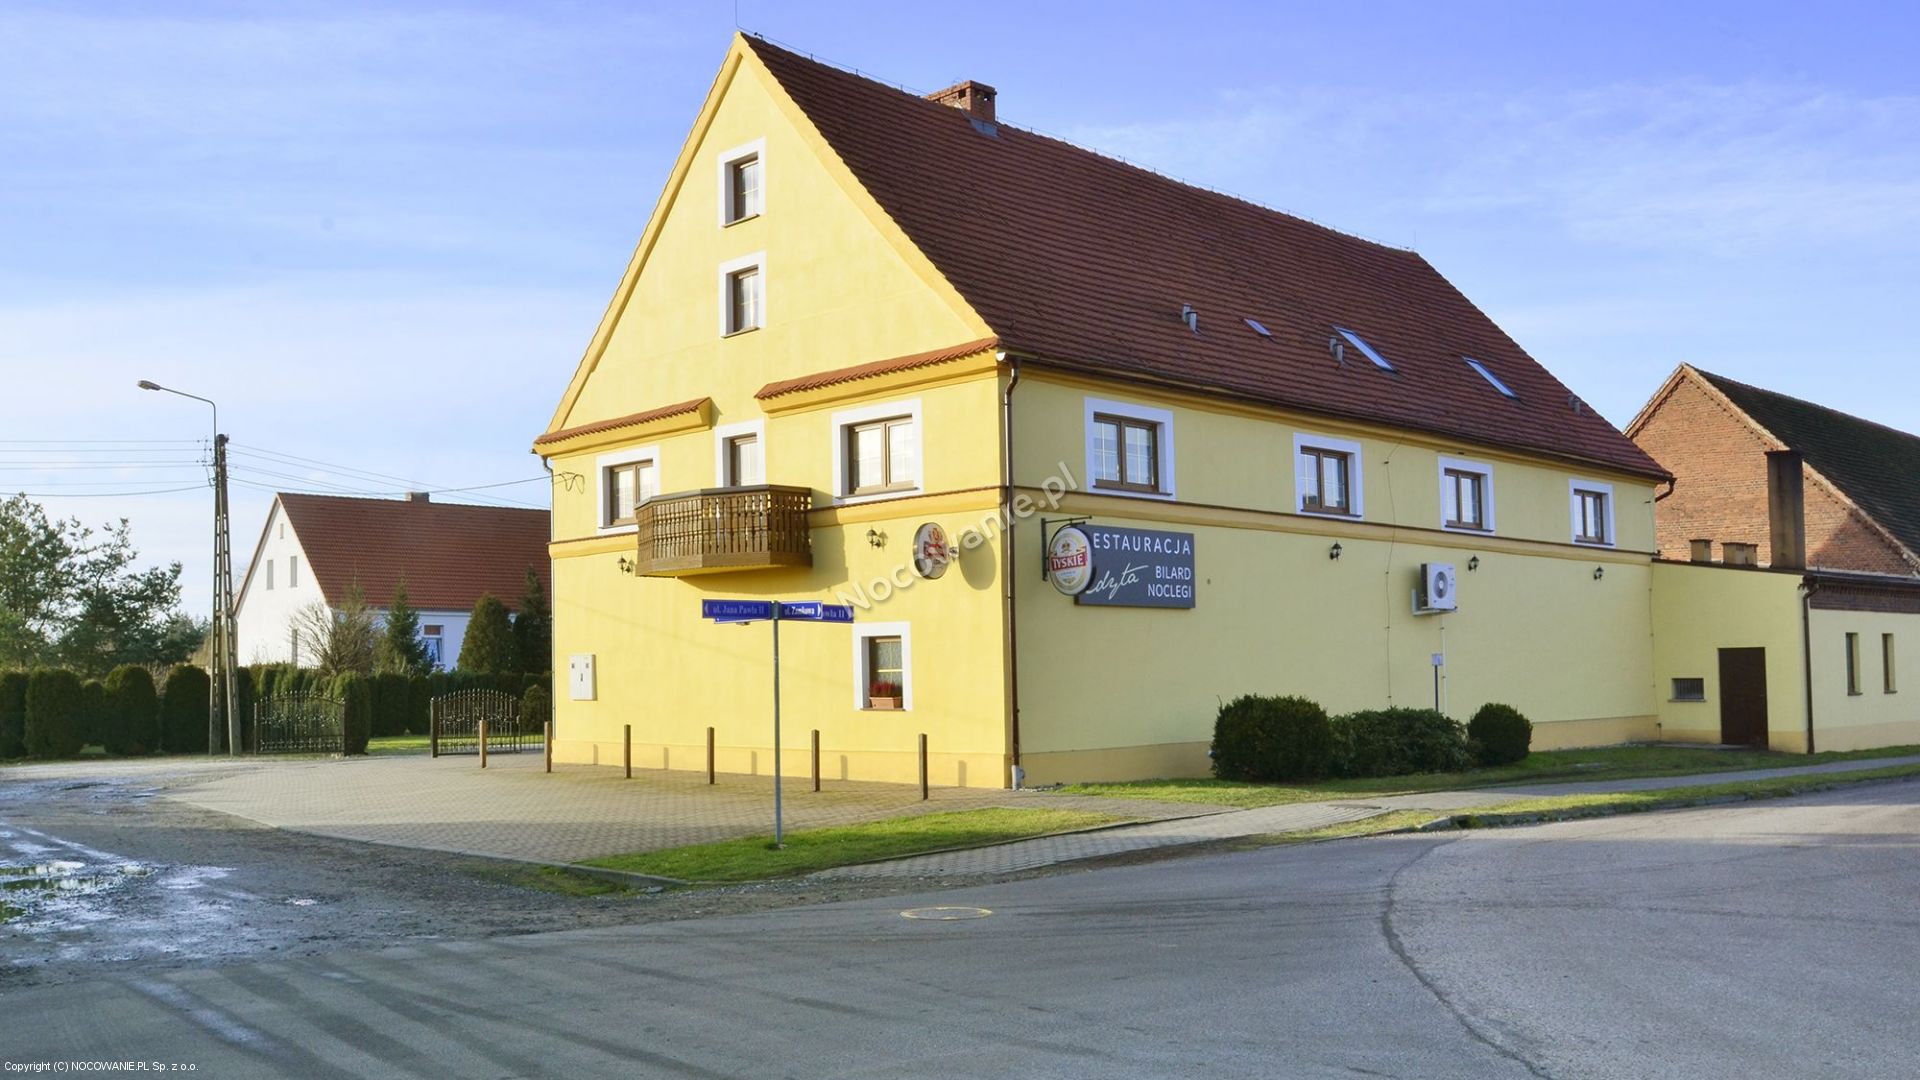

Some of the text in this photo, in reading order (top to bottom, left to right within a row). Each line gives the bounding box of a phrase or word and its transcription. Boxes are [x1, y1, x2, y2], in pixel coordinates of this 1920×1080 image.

[1092, 532, 1191, 555] ESTAURACJA
[1052, 553, 1084, 570] TYSKIE
[1155, 565, 1192, 580] BILARD
[1085, 562, 1149, 600] dyta
[1147, 583, 1192, 599] NOCLEGI
[722, 604, 738, 614] Jana
